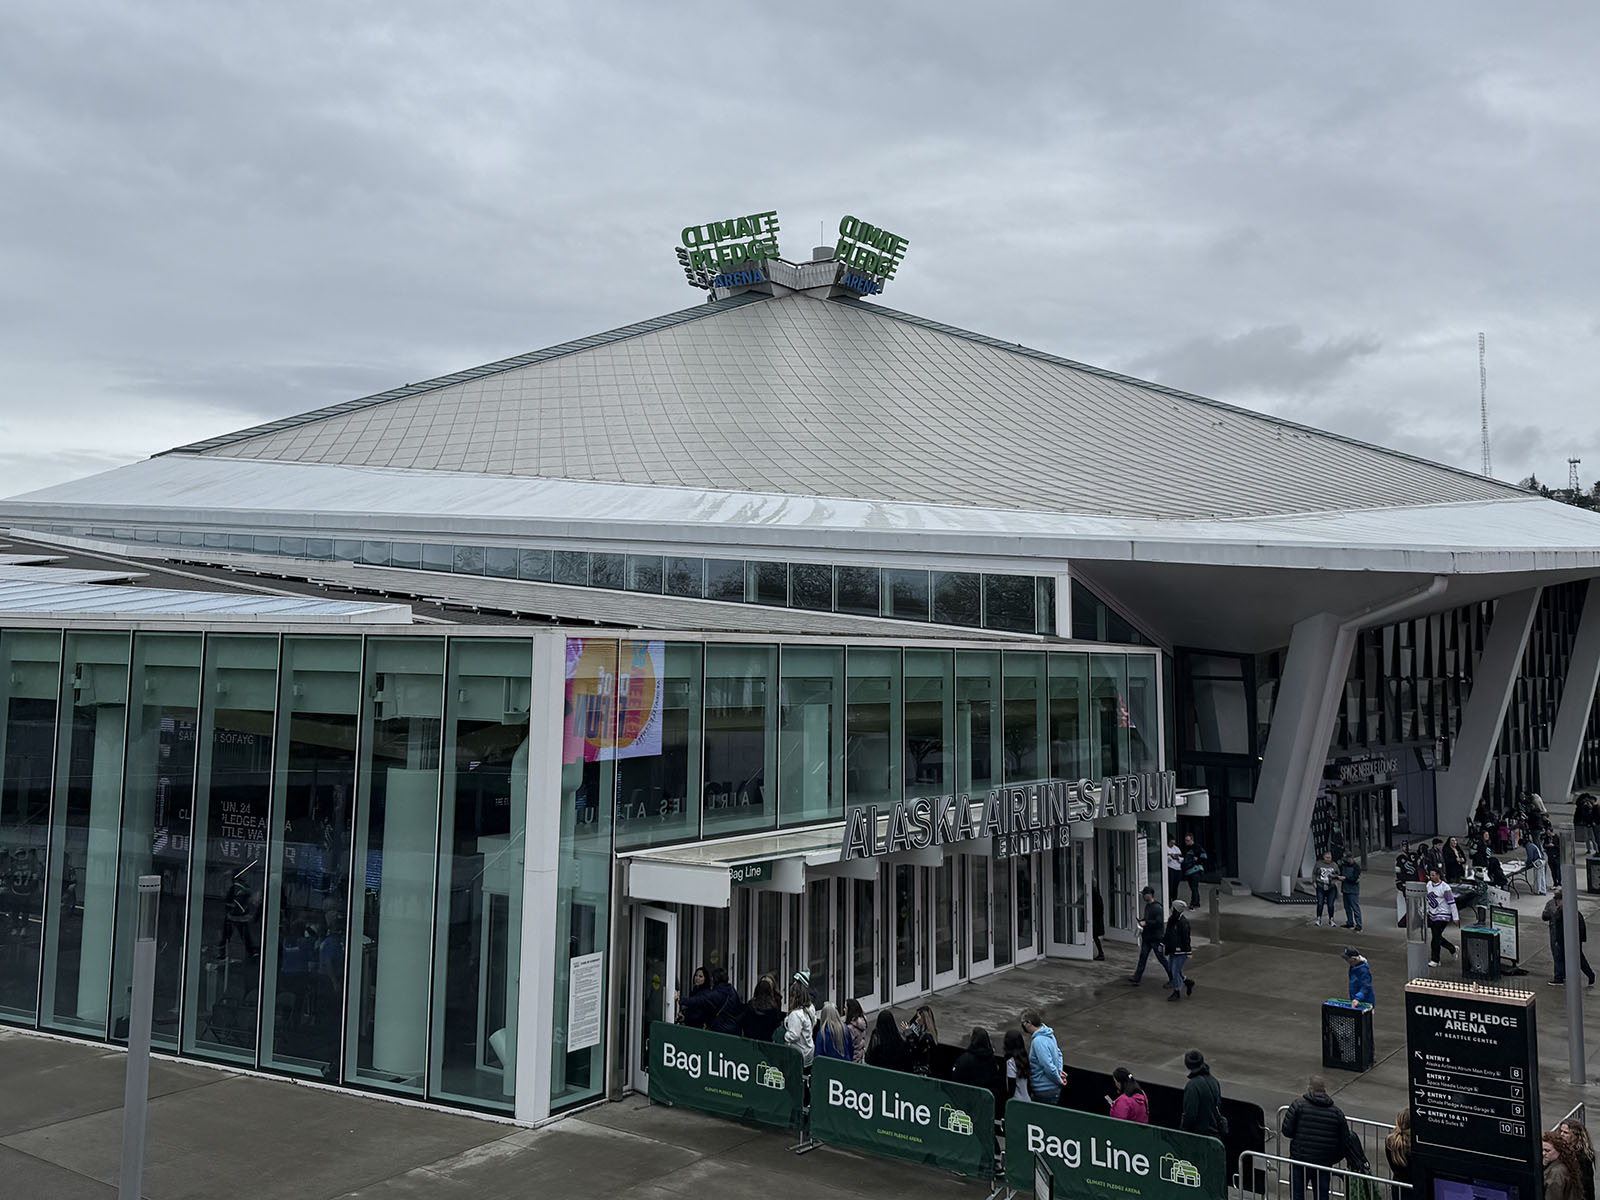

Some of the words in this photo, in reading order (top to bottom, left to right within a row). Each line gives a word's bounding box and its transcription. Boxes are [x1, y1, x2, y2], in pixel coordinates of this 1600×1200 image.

[681, 210, 780, 248] CLIMATE
[839, 215, 910, 259] CLIMATE
[690, 236, 780, 271] PLEDGE
[834, 238, 900, 281] PLEDGE
[715, 268, 765, 288] ARENA
[844, 273, 879, 295] ARENA
[221, 801, 239, 812] UN.
[845, 794, 976, 861] ALASKA
[980, 778, 1097, 838] AIRLINES
[1100, 770, 1177, 818] ATRIUM
[997, 829, 1052, 859] ENTRY
[1060, 826, 1070, 848] 8
[745, 862, 762, 877] Line
[1415, 1005, 1466, 1020] CLIMATE
[1470, 1012, 1518, 1027] PLEDGE
[1445, 1020, 1487, 1034] ARENA
[1444, 1033, 1471, 1041] SEATTLE
[1473, 1036, 1498, 1045] CENTER
[663, 1042, 701, 1078] Bag
[708, 1051, 750, 1082] Line
[1426, 1054, 1445, 1062] ENTRY
[1483, 1068, 1495, 1077] Entry
[1513, 1069, 1520, 1078] 8
[1440, 1081, 1456, 1089] Needle
[1456, 1083, 1473, 1092] Lounge
[1514, 1088, 1520, 1096] 7
[828, 1079, 873, 1119] Bag
[881, 1090, 931, 1125] Line
[1427, 1092, 1446, 1100] ENTRY
[1428, 1110, 1447, 1118] ENTRY
[1515, 1106, 1521, 1114] 9
[1501, 1124, 1511, 1132] 10
[1514, 1126, 1523, 1134] 11
[1027, 1124, 1081, 1168] Bag
[1091, 1137, 1150, 1176] Line
